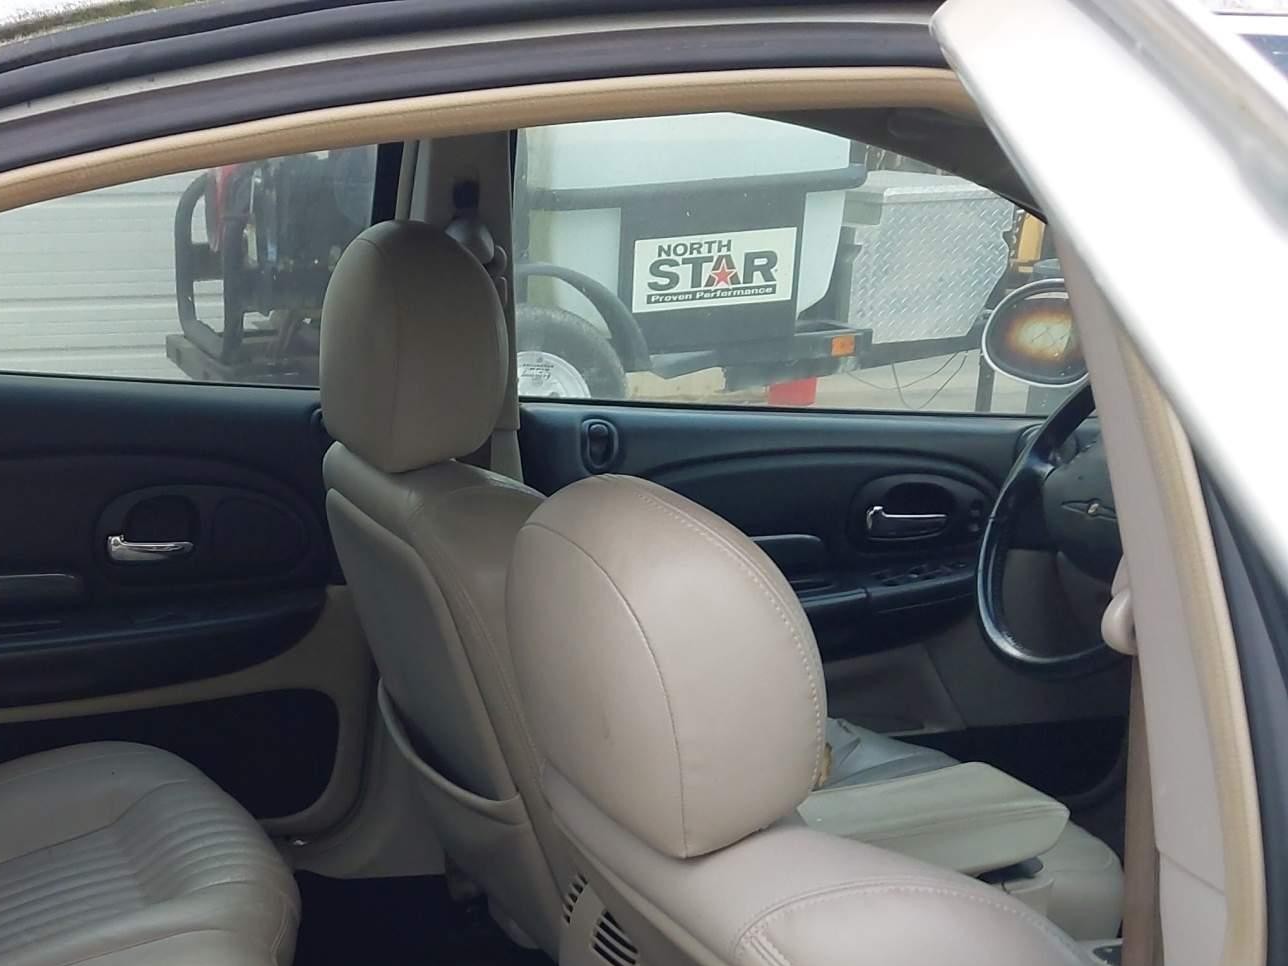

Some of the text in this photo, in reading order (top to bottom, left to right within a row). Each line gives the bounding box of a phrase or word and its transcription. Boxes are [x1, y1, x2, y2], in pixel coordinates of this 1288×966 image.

[657, 239, 732, 257] NORTH
[648, 250, 778, 292] STAR
[651, 287, 773, 303] Proven Performance
